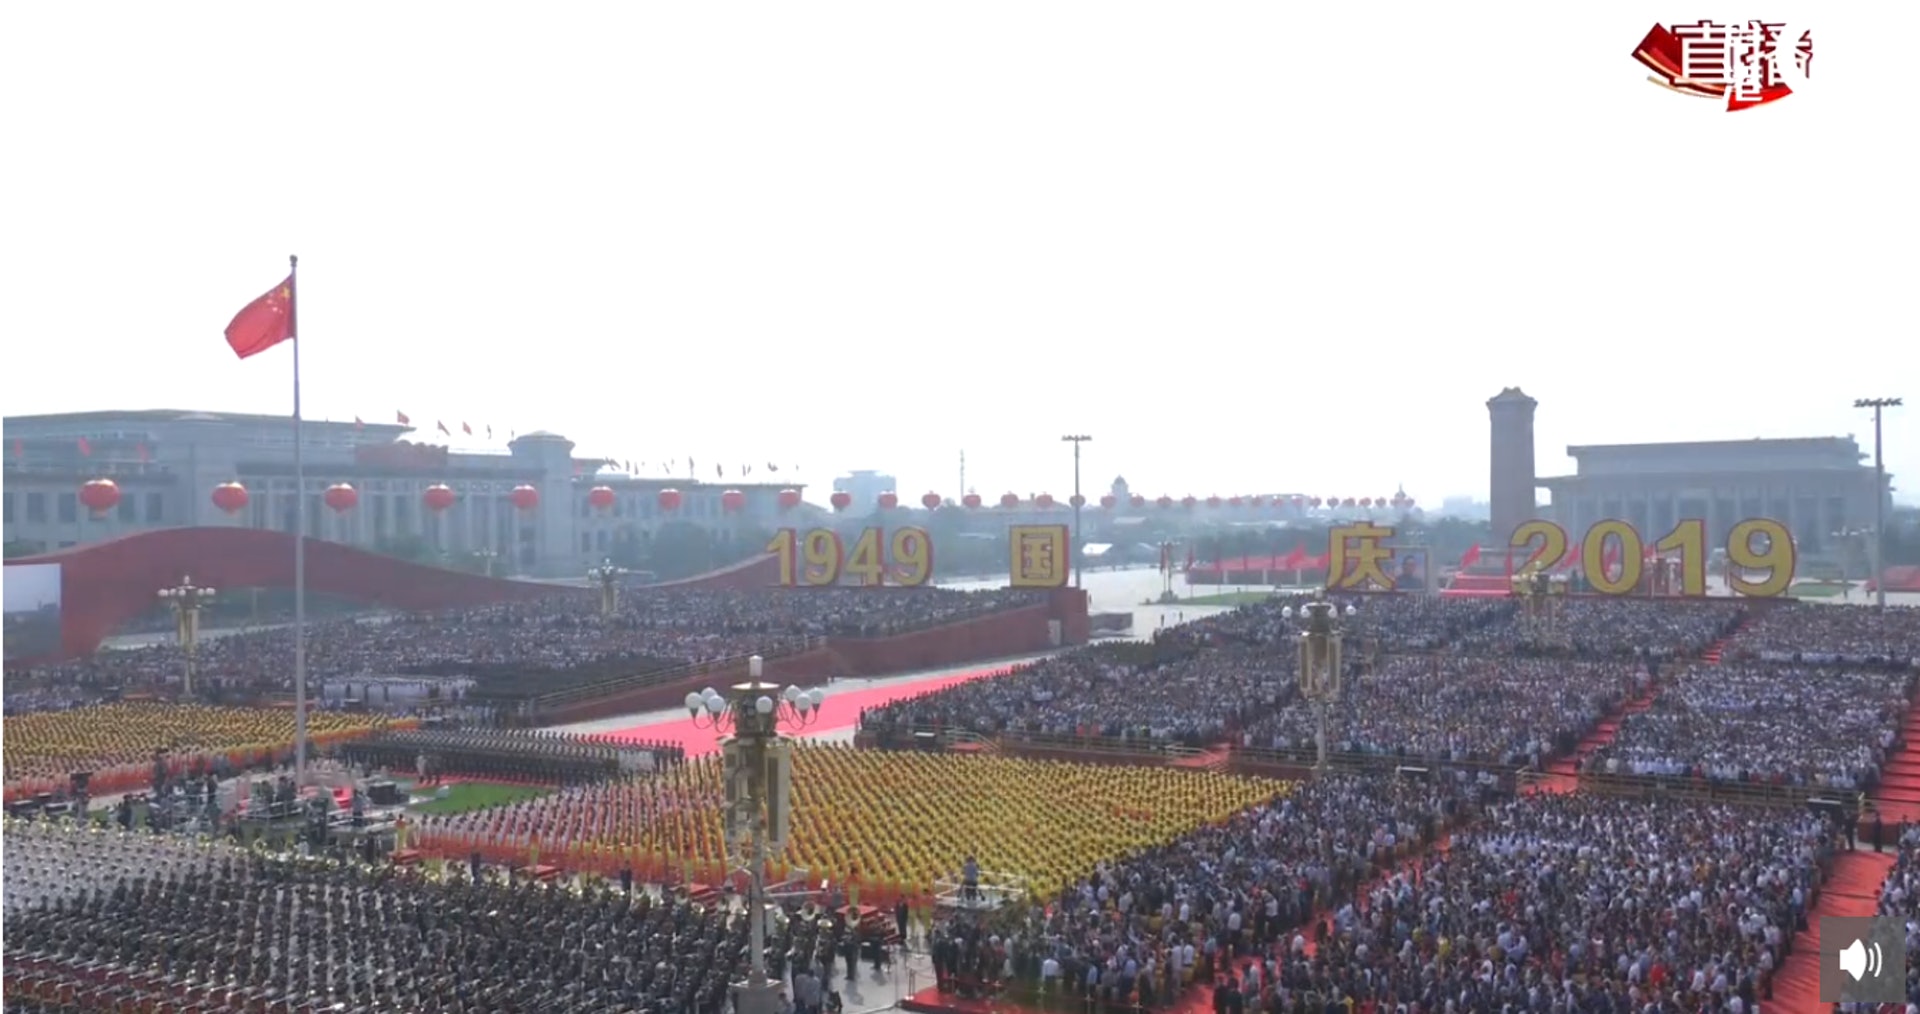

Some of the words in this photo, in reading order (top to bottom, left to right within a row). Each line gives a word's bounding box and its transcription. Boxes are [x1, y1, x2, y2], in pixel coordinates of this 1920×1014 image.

[766, 526, 934, 587] 1949
[1009, 524, 1069, 587] 国
[1326, 521, 1396, 592] 庆
[1509, 518, 1795, 597] 2019
